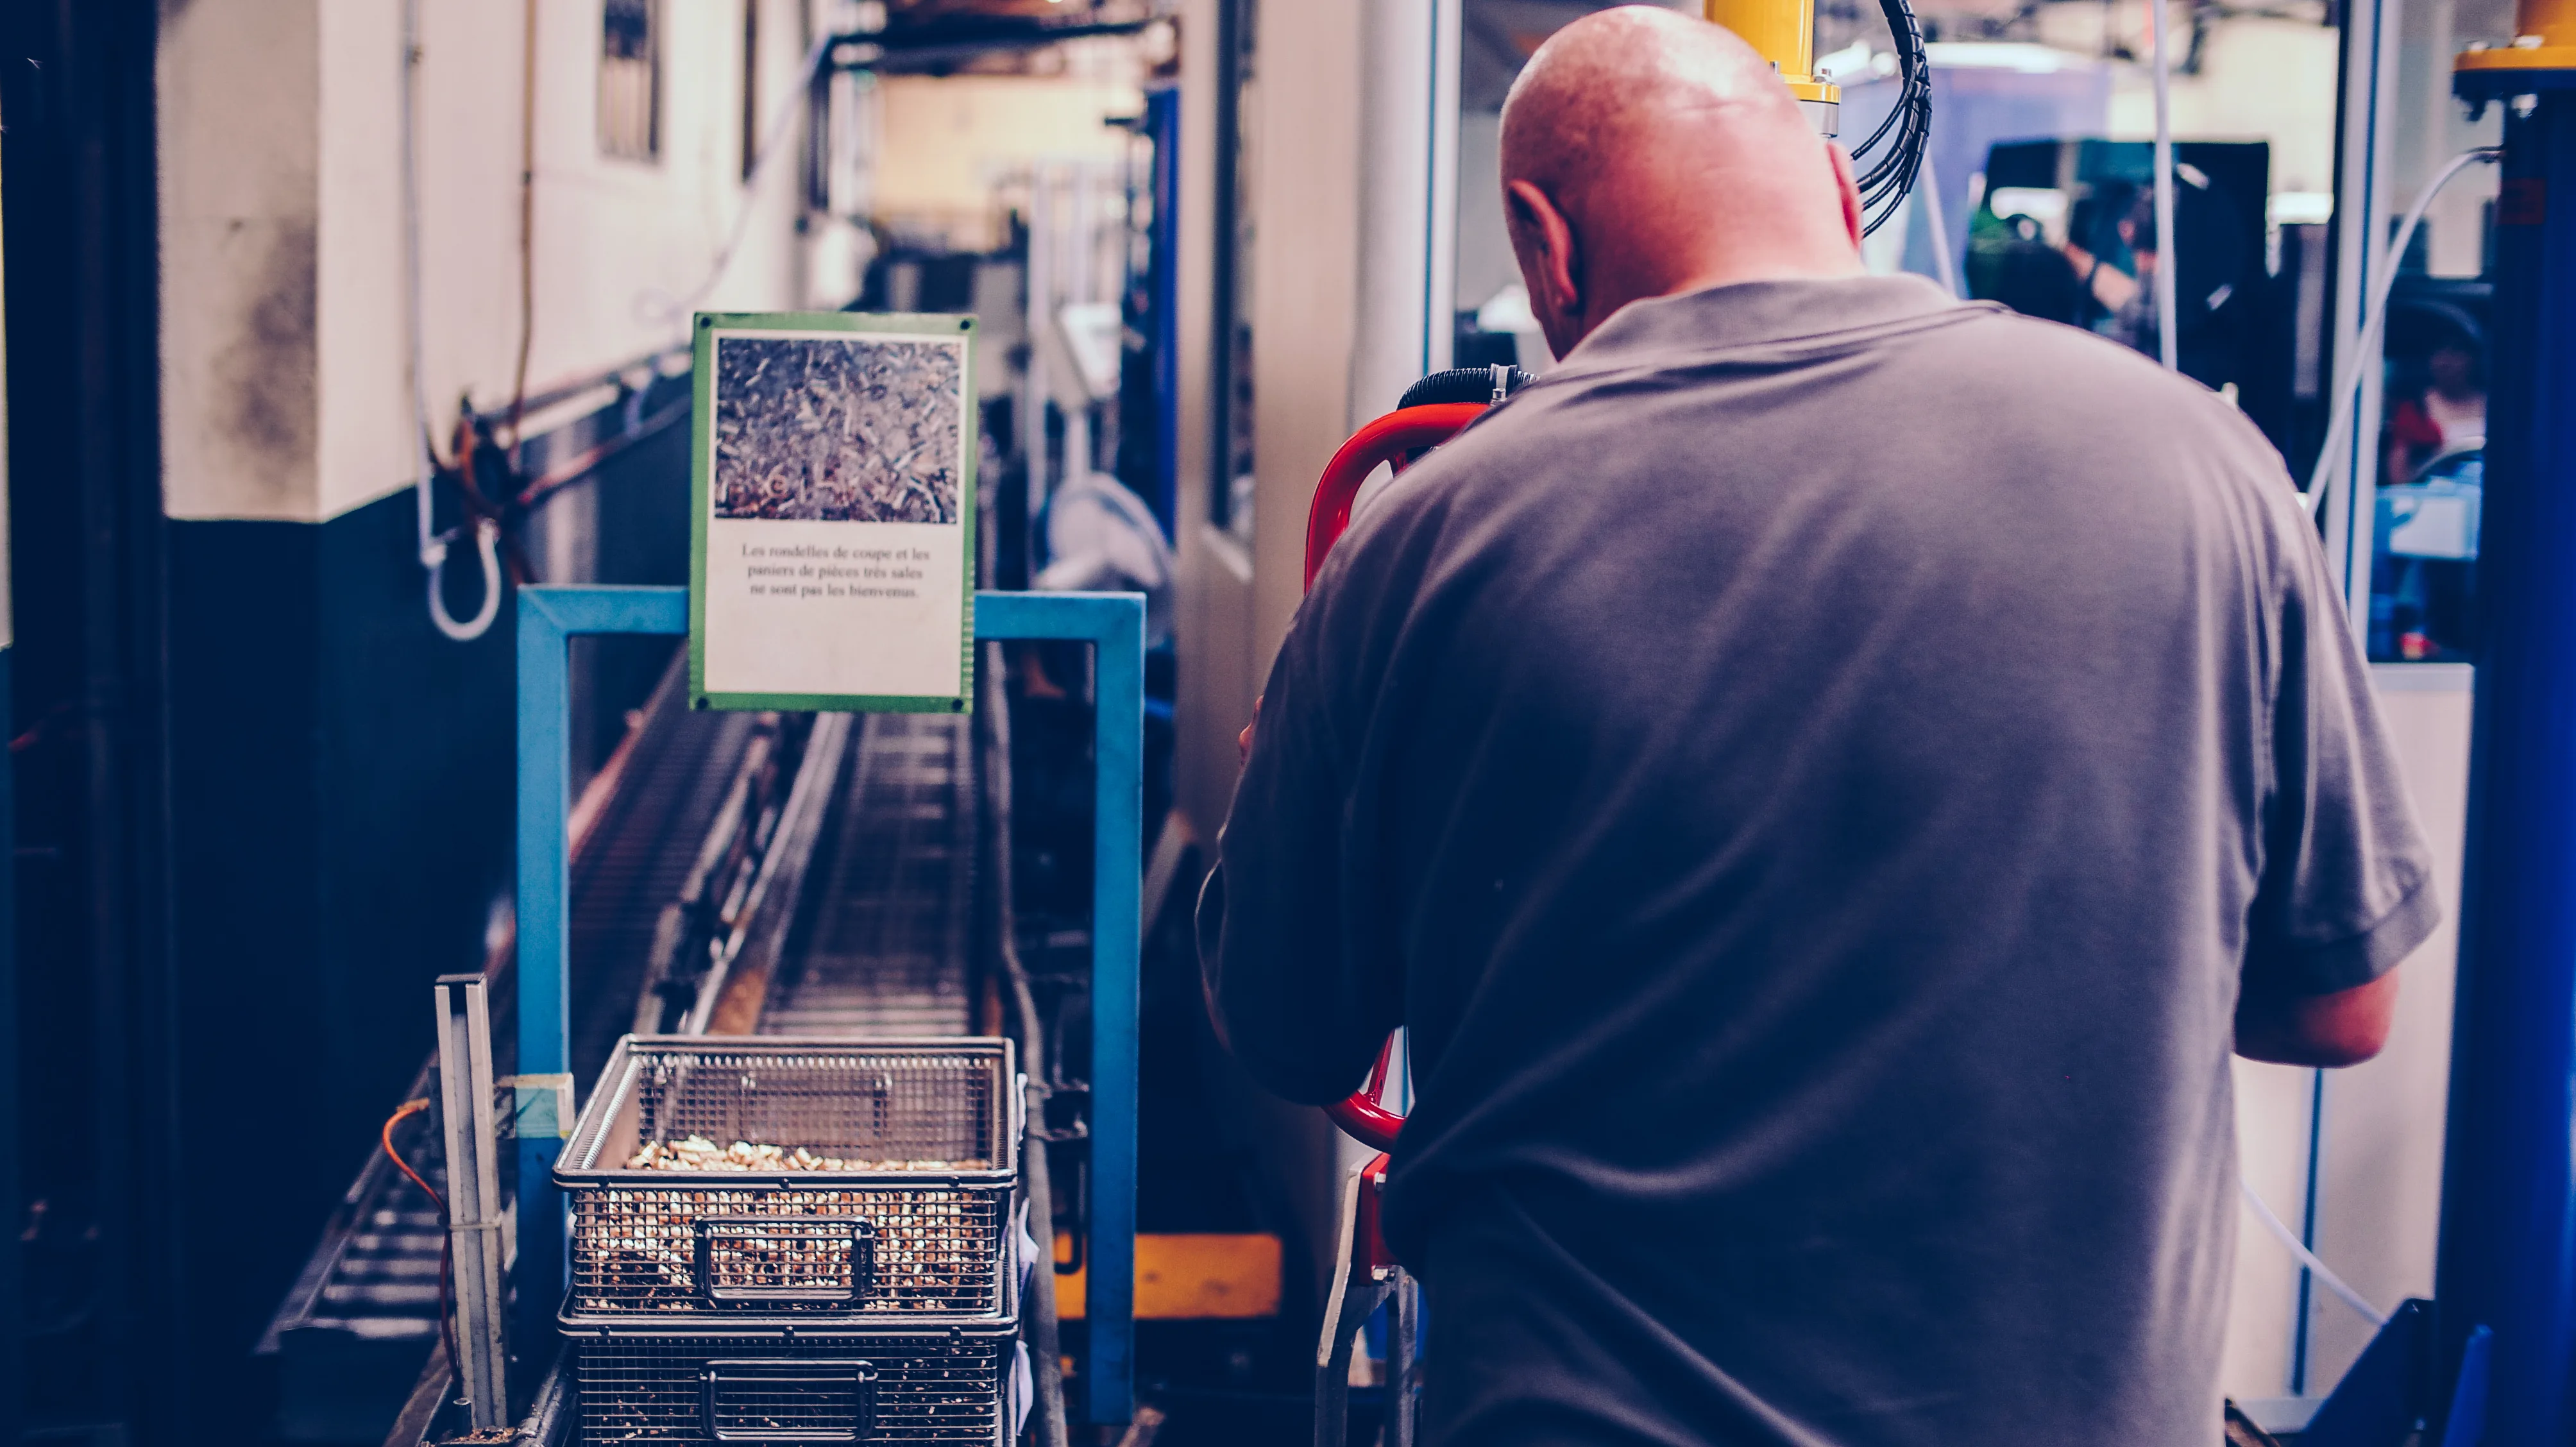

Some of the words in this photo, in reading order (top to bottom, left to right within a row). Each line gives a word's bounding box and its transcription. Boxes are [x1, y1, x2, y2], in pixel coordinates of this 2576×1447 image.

[742, 543, 764, 557] Les
[770, 545, 829, 557] rondelles
[833, 545, 848, 559] de
[853, 550, 892, 561] coupe
[896, 548, 907, 559] et
[913, 547, 929, 560] les
[748, 565, 794, 579] paniers
[799, 565, 813, 577] de
[891, 568, 922, 579] sales
[750, 585, 765, 594] ne
[770, 584, 797, 595] sont
[801, 587, 822, 599] pas
[828, 585, 844, 596] les
